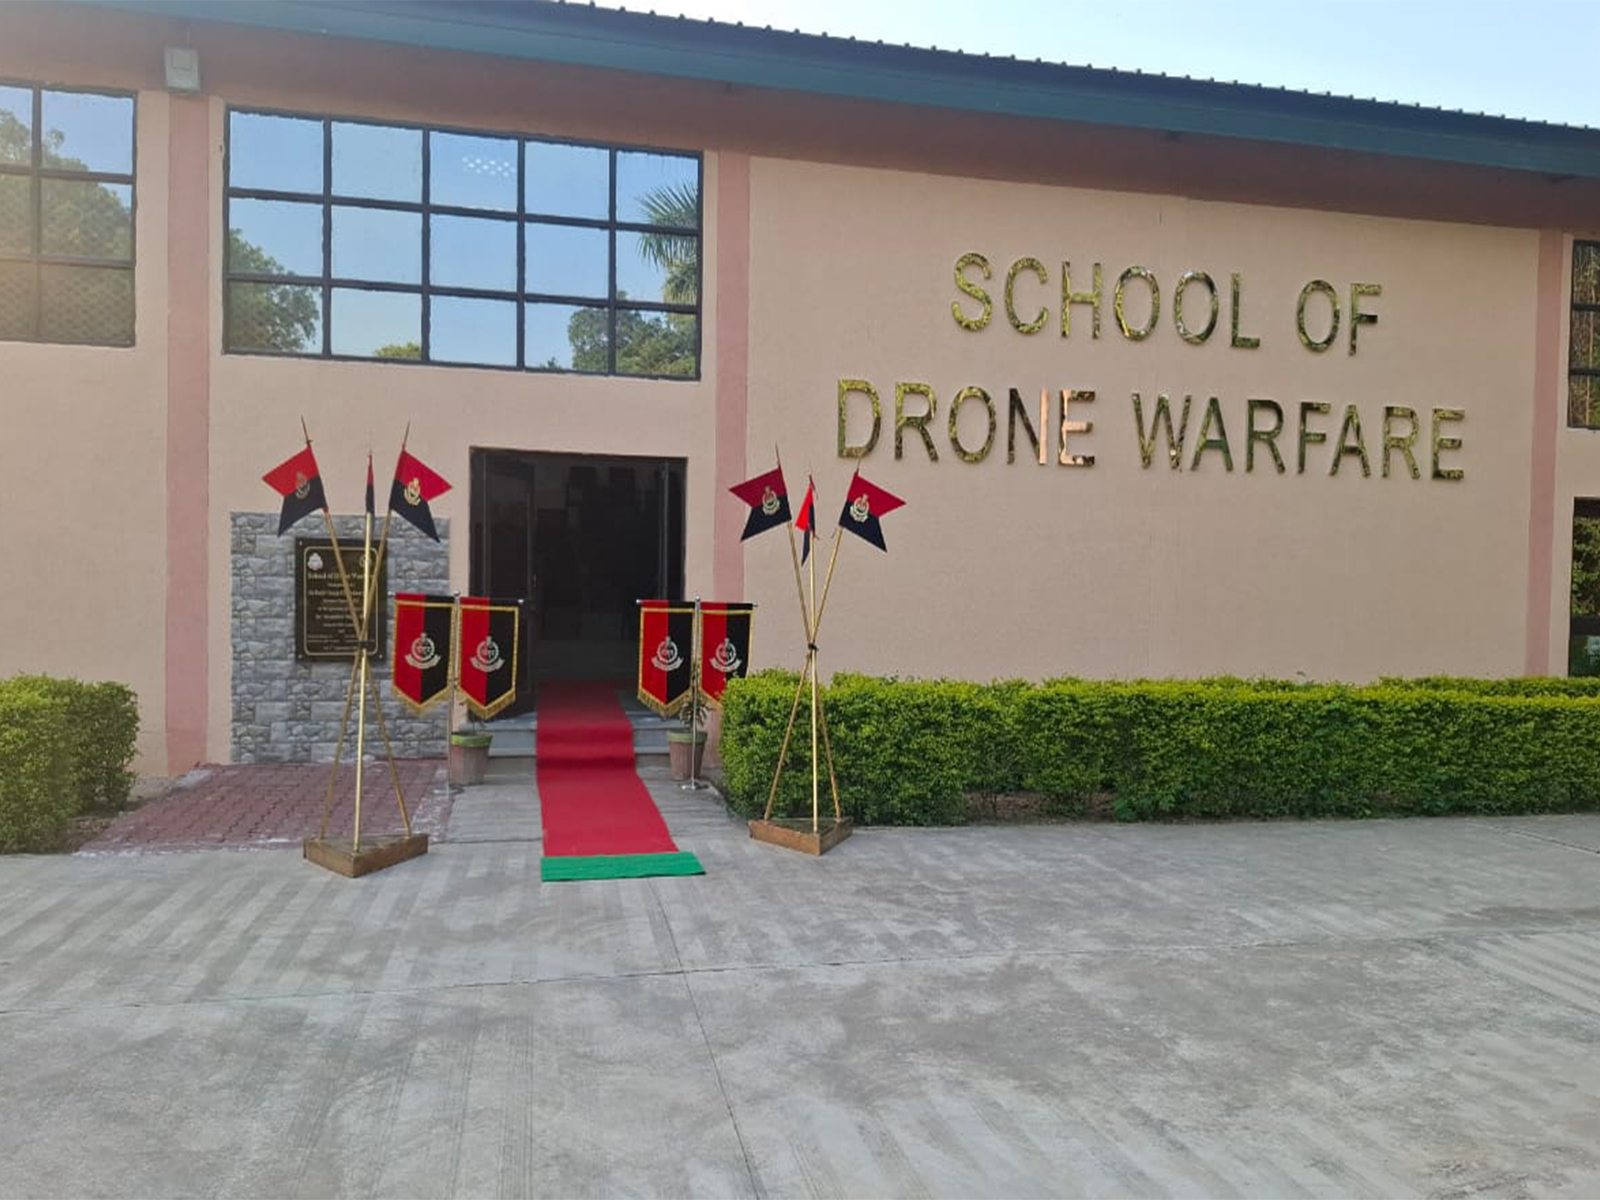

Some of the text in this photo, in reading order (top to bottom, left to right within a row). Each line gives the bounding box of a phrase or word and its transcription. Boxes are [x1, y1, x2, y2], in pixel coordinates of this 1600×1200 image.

[951, 252, 1382, 356] SCHOOL OF
[837, 379, 1466, 480] DRONE WARFARE
